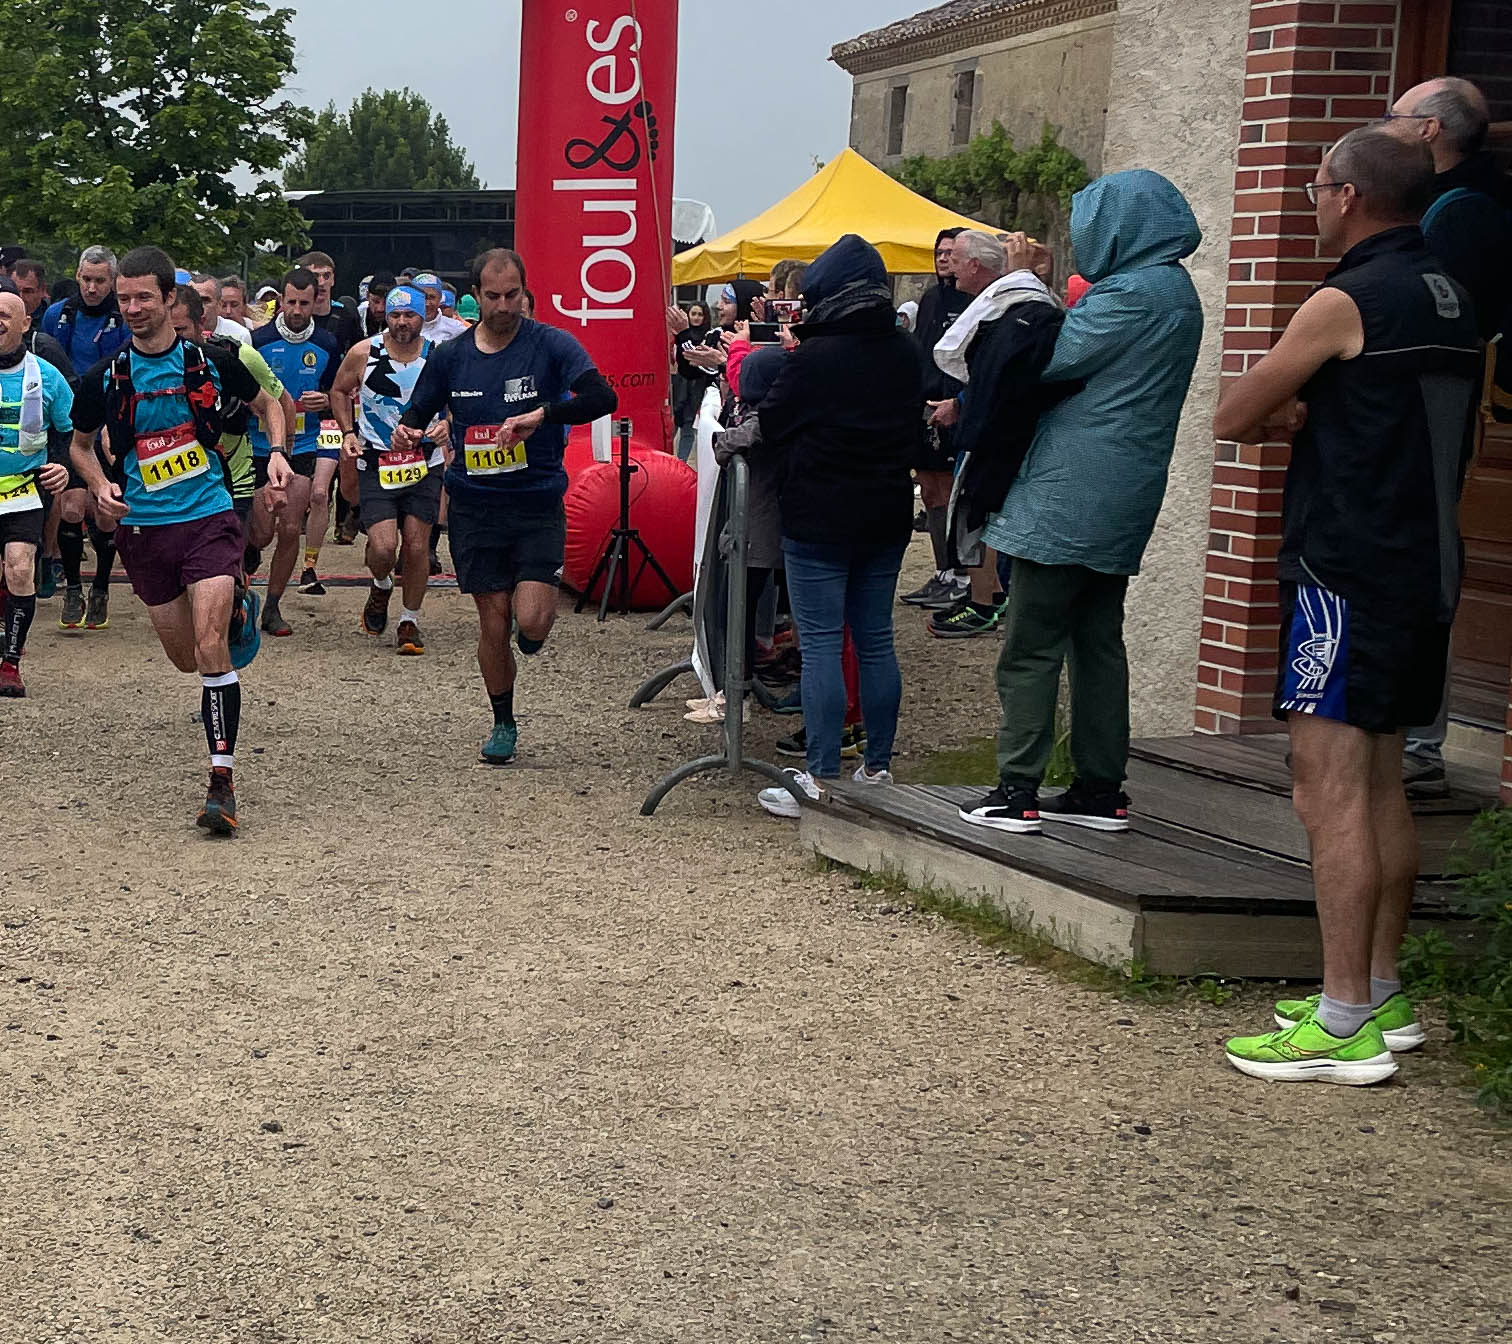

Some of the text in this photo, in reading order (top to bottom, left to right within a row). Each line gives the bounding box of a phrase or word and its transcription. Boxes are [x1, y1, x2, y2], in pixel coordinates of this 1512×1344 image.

[149, 450, 200, 481] 1118
[472, 449, 517, 467] 1101
[386, 467, 422, 484] 1129
